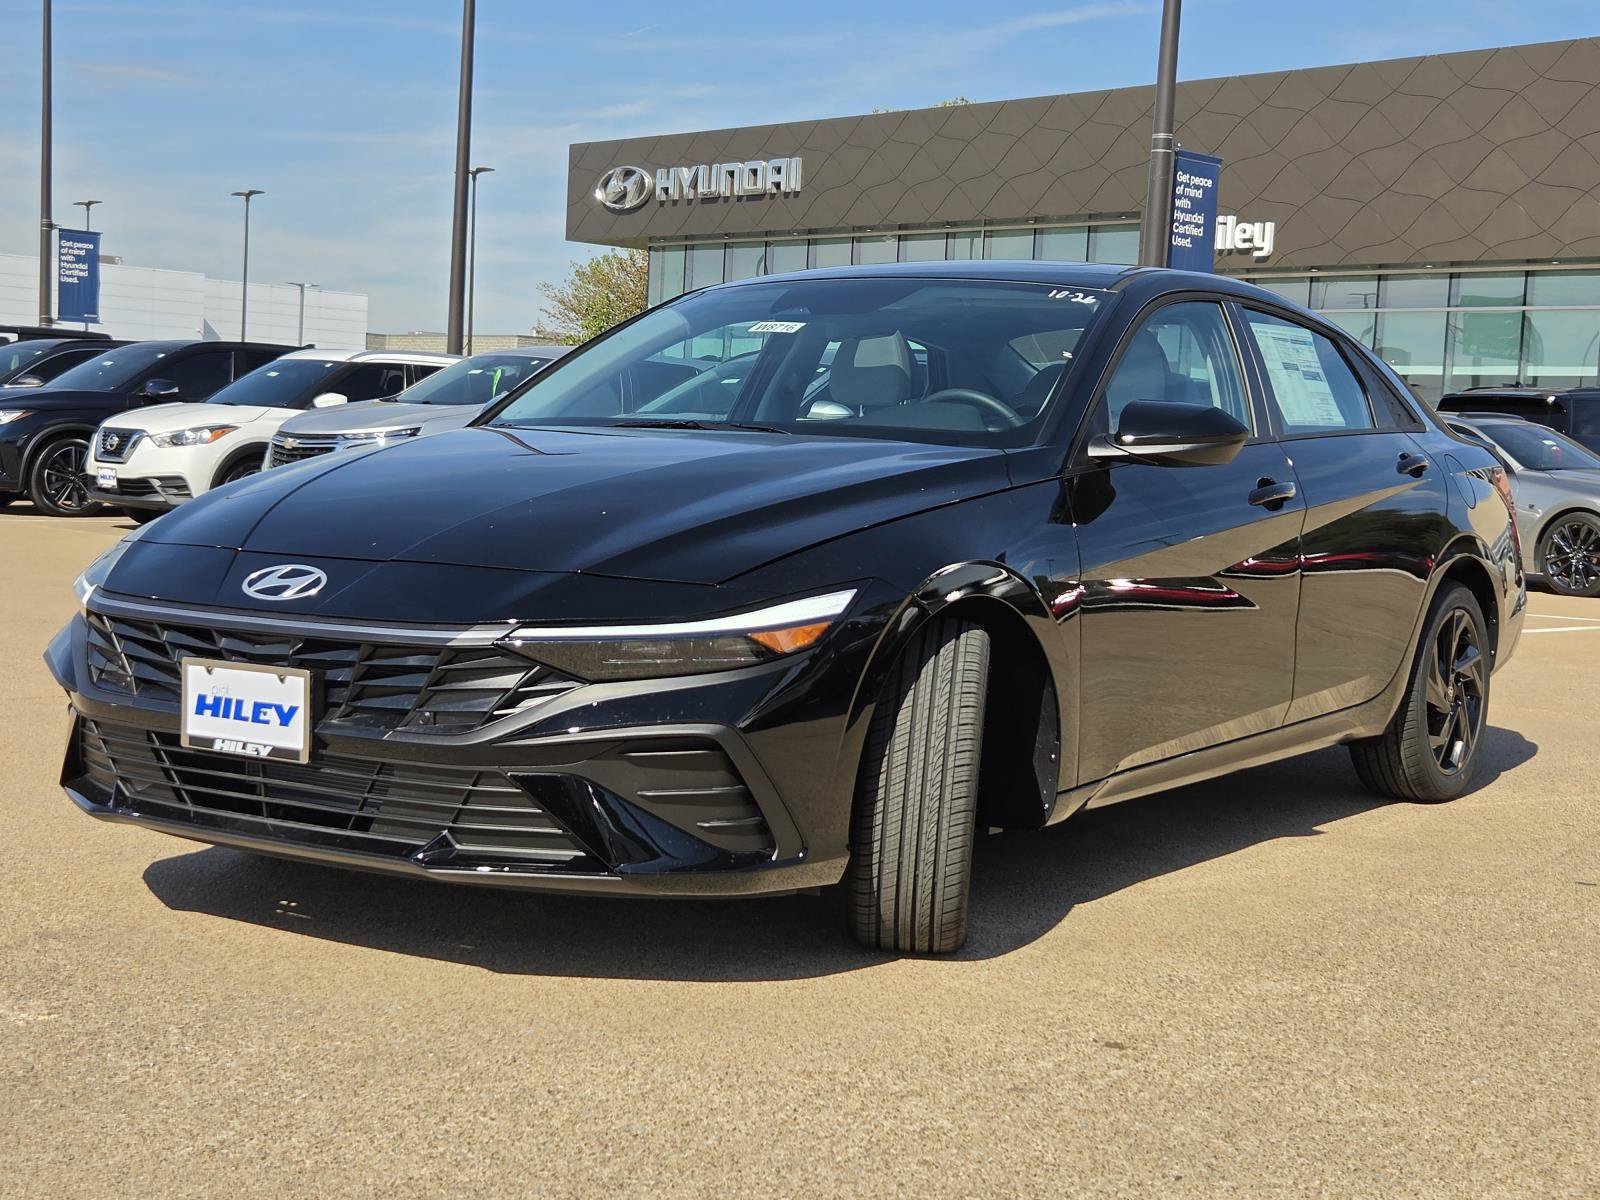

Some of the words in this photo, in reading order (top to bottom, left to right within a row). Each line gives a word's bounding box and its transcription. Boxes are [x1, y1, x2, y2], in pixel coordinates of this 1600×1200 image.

[656, 157, 802, 201] HYUNDAI
[1177, 171, 1190, 183] Get
[1190, 176, 1212, 187] peace
[1176, 184, 1184, 195] of
[1184, 187, 1202, 198] mind
[1175, 197, 1191, 209] with
[1173, 209, 1204, 224] Hyundai
[1173, 223, 1203, 236] Certified
[1214, 215, 1275, 256] iley
[1172, 235, 1192, 247] Used.
[60, 261, 88, 270] Hyundai
[60, 268, 88, 277] Certified
[1048, 289, 1097, 304] 10-26
[195, 694, 300, 727] HILEY
[213, 738, 274, 757] HILEY
